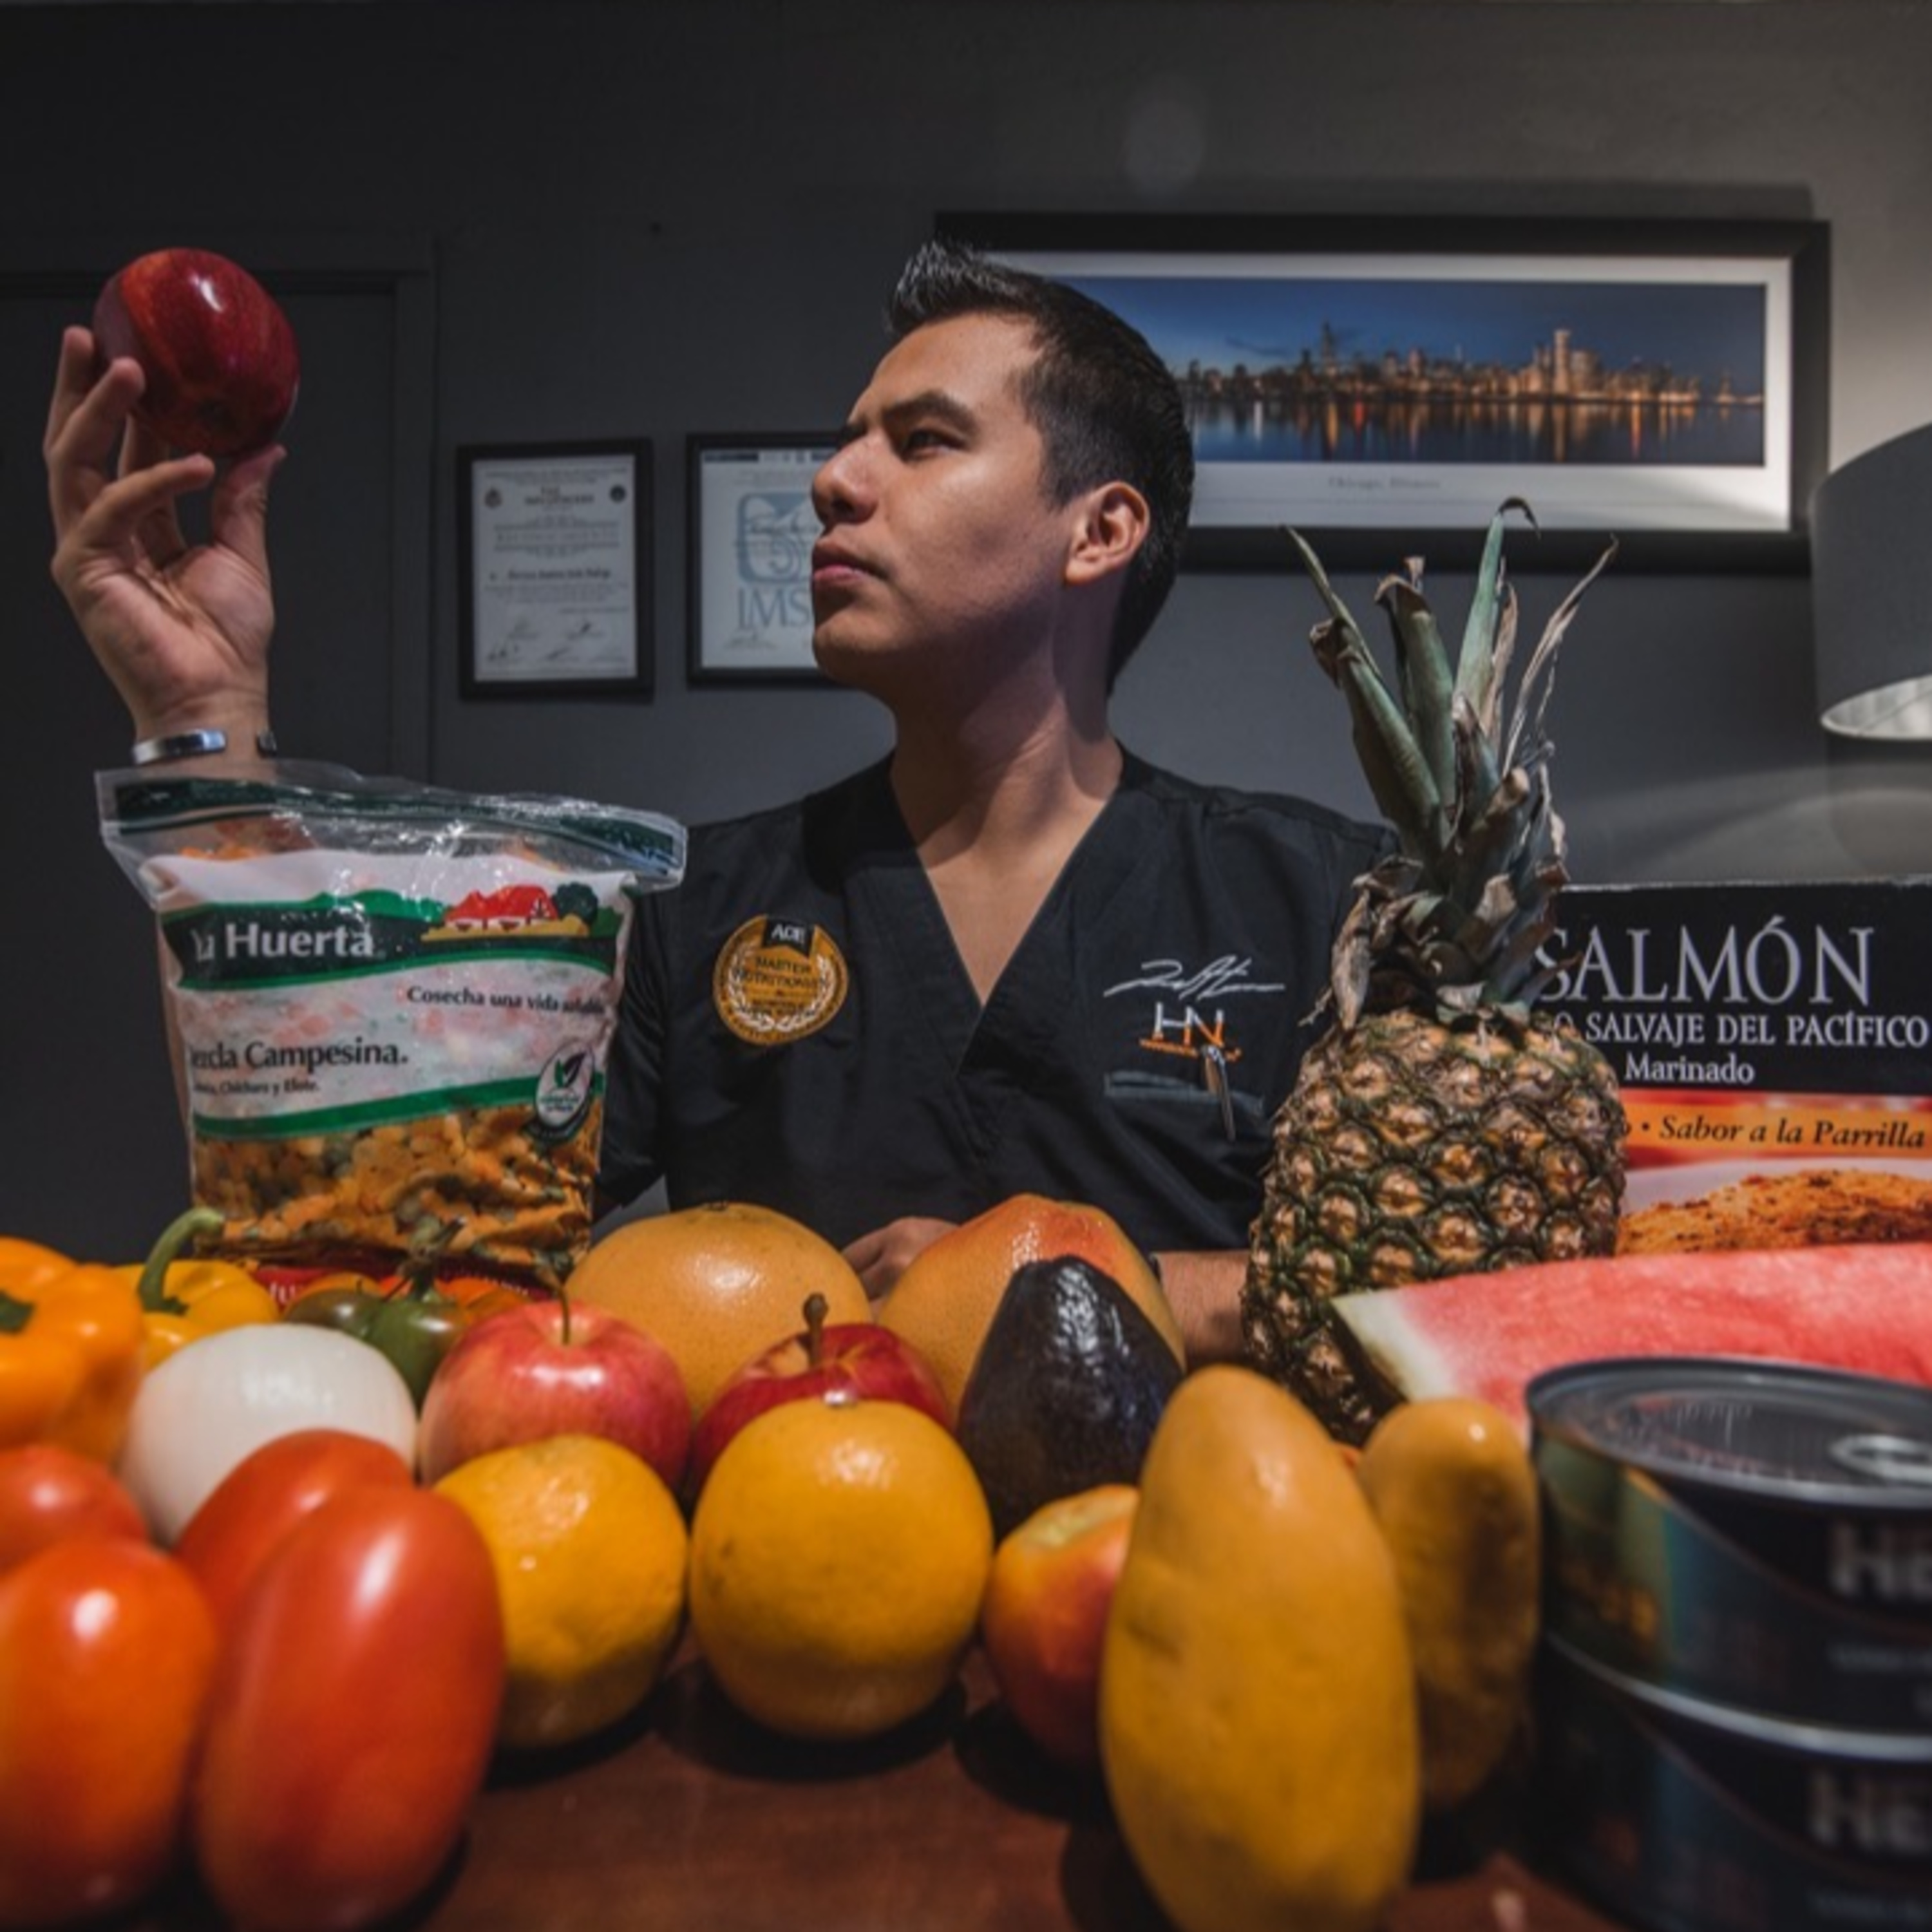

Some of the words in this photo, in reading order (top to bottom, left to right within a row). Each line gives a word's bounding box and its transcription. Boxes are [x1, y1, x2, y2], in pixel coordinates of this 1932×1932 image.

[739, 587, 813, 629] IMS
[224, 922, 374, 960] Huerta
[1535, 914, 1875, 1007] SALMÓN
[406, 985, 486, 1007] Cosecha
[489, 995, 523, 1009] una
[527, 993, 559, 1011] vida
[1586, 1012, 1705, 1048] SALVAJE
[1717, 1015, 1776, 1045] DEL
[1786, 1009, 1928, 1048] PACÍFICO
[245, 1036, 409, 1073] Campesina.
[1624, 1052, 1756, 1084] Marinado
[1659, 1115, 1742, 1142] Sabor
[1749, 1124, 1768, 1143] a
[1776, 1118, 1803, 1144] la
[1813, 1121, 1925, 1149] Parrilla
